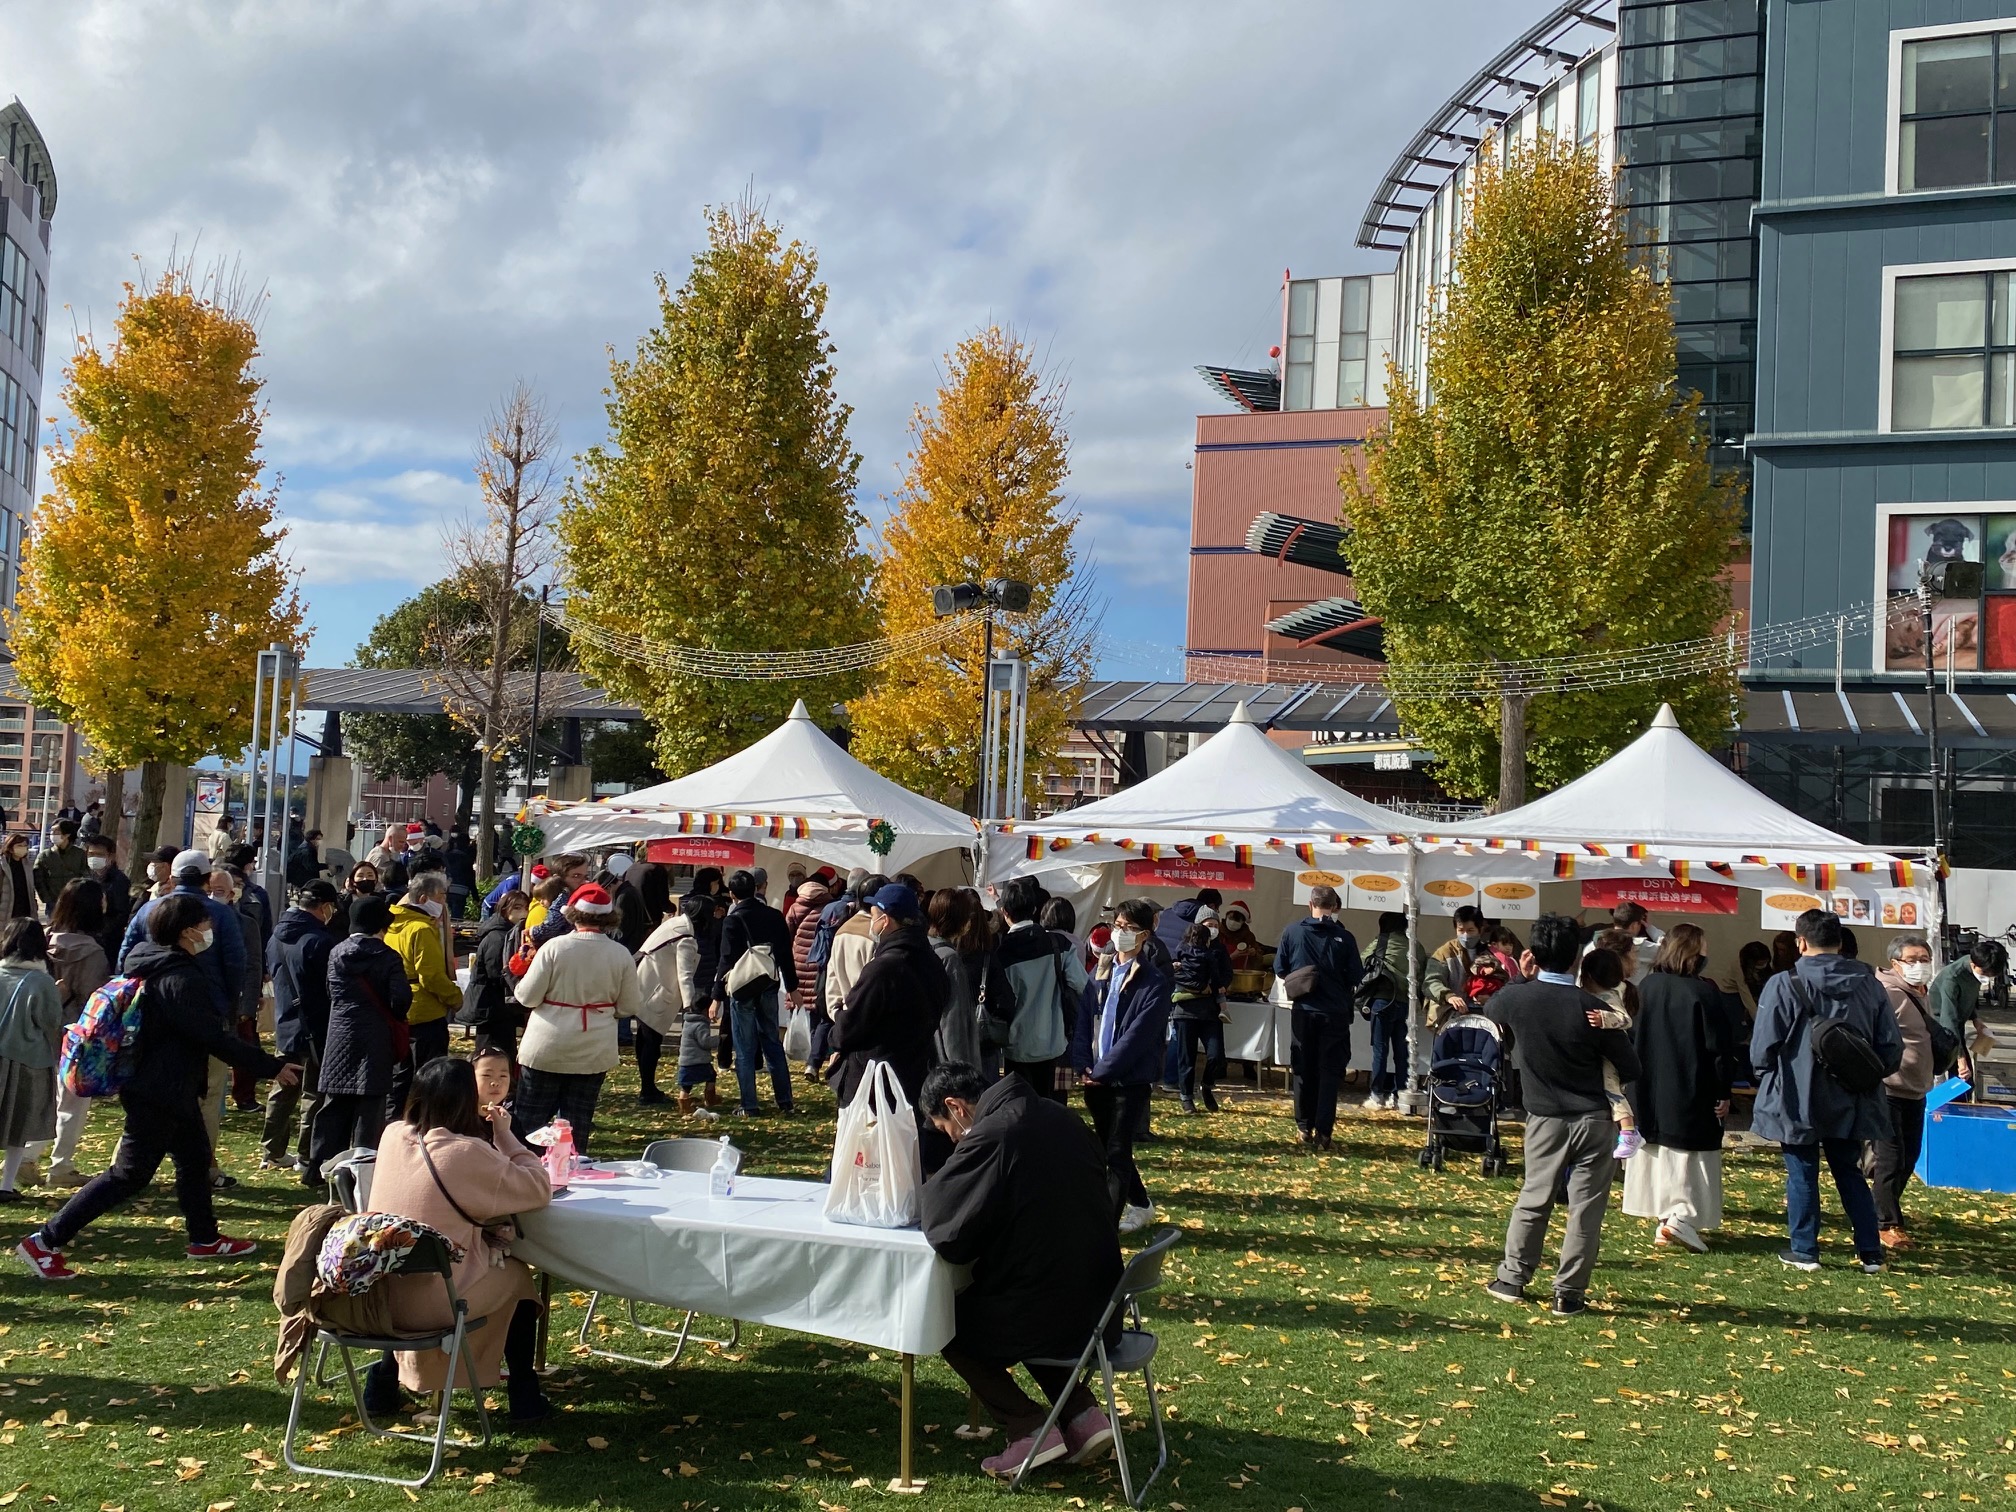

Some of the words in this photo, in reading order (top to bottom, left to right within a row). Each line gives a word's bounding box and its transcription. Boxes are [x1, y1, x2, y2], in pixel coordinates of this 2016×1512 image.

[689, 838, 712, 846] DSTY
[1643, 879, 1675, 888] DSTY
[1495, 886, 1526, 894] クッキー
